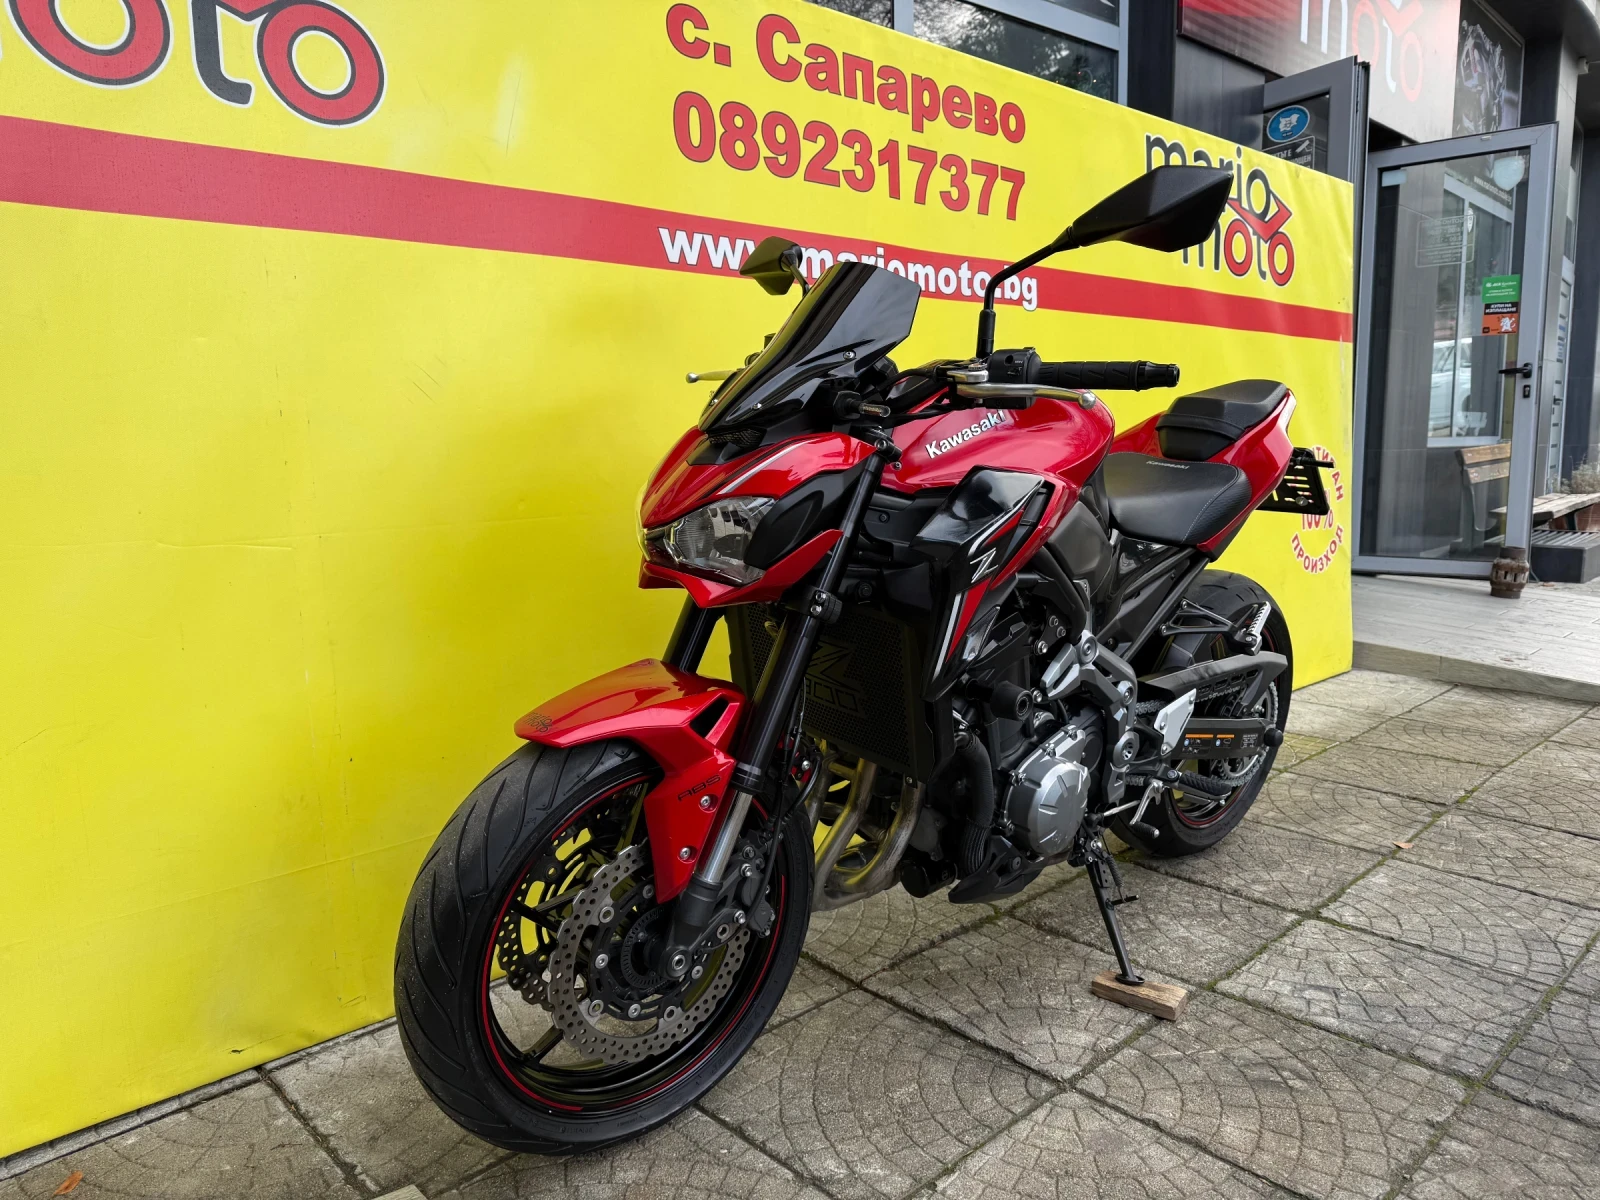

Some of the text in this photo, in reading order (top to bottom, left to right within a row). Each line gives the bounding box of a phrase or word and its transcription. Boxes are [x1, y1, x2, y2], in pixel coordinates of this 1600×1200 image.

[8, 0, 387, 127] oto
[666, 3, 1026, 143] с. Сапарево
[673, 90, 1025, 221] 0892317377
[925, 408, 1006, 459] Kawasaki
[1291, 525, 1344, 574] ПРОИЗХОД
